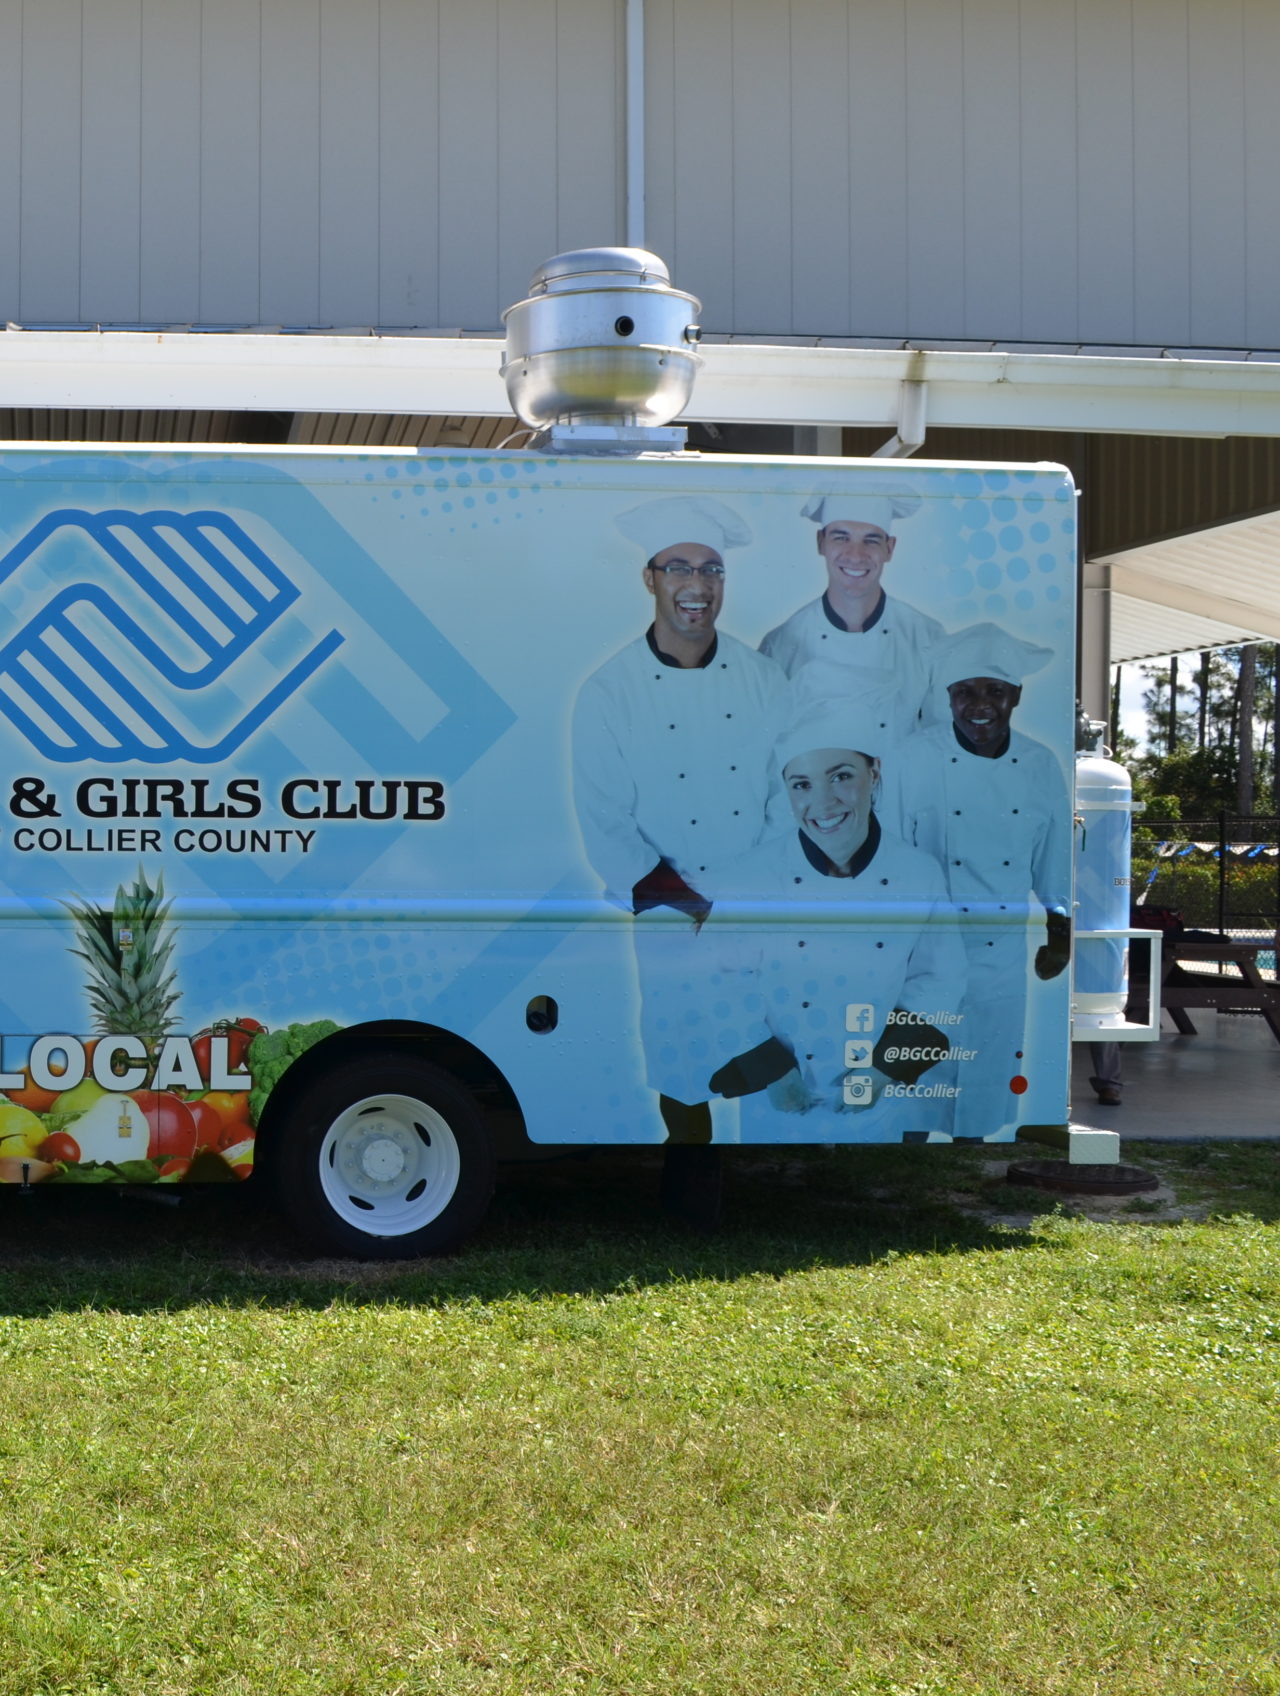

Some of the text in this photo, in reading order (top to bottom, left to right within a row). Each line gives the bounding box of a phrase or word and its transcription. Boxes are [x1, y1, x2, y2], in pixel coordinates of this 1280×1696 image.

[9, 777, 61, 818] &
[76, 779, 261, 818] GIRLS
[281, 780, 446, 820] CLUB
[13, 828, 162, 852] COLLIER
[174, 829, 317, 853] COUNTY
[886, 1011, 964, 1026] BGCCollier
[883, 1047, 978, 1063] @BGCCollier
[883, 1084, 962, 1098] BGCCollier
